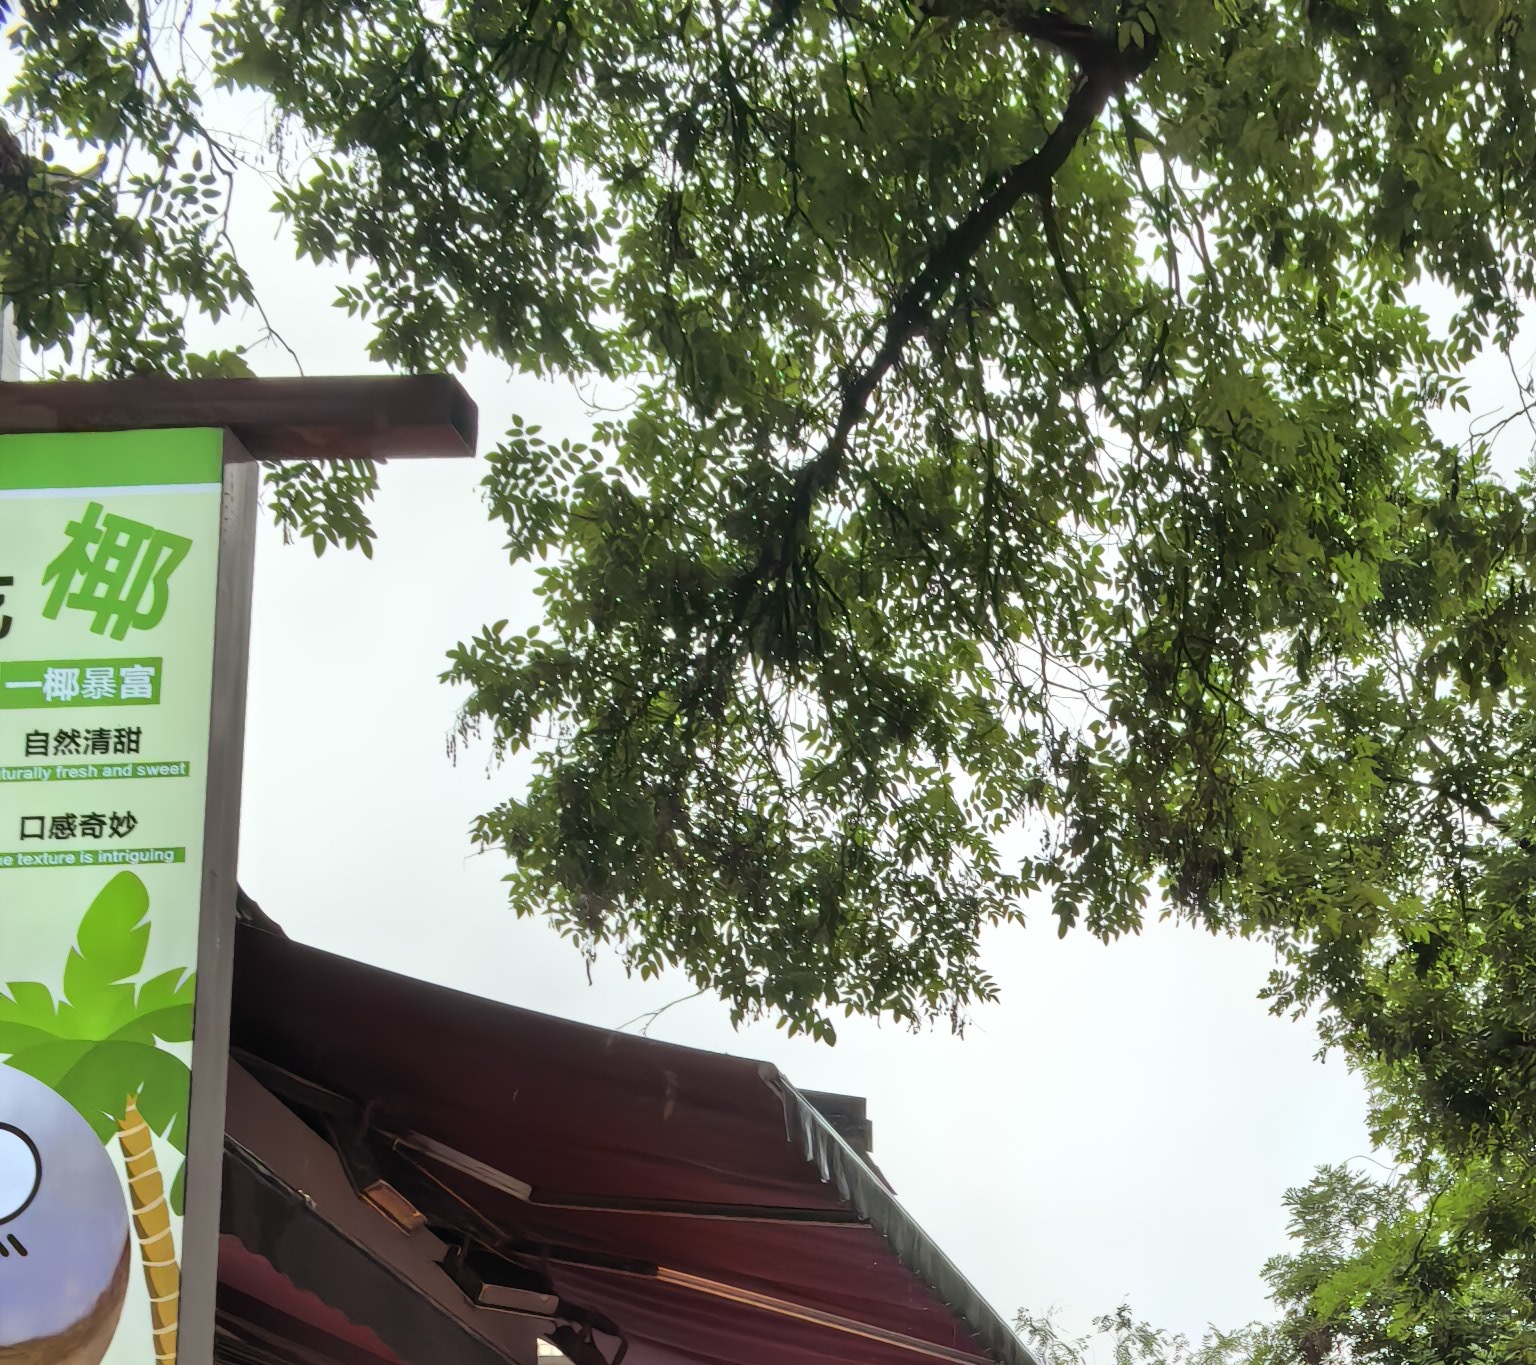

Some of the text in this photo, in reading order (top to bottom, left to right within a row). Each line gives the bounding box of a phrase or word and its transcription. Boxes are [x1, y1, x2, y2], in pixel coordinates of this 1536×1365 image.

[5, 664, 156, 703] 一椰暴富
[24, 726, 142, 758] 自然清甜
[55, 765, 99, 779] fresh
[102, 763, 132, 777] and
[137, 762, 187, 776] sweet
[20, 810, 138, 841] 口感奇妙
[17, 852, 76, 866] texture
[80, 850, 94, 864] is
[99, 848, 175, 864] intriguing
